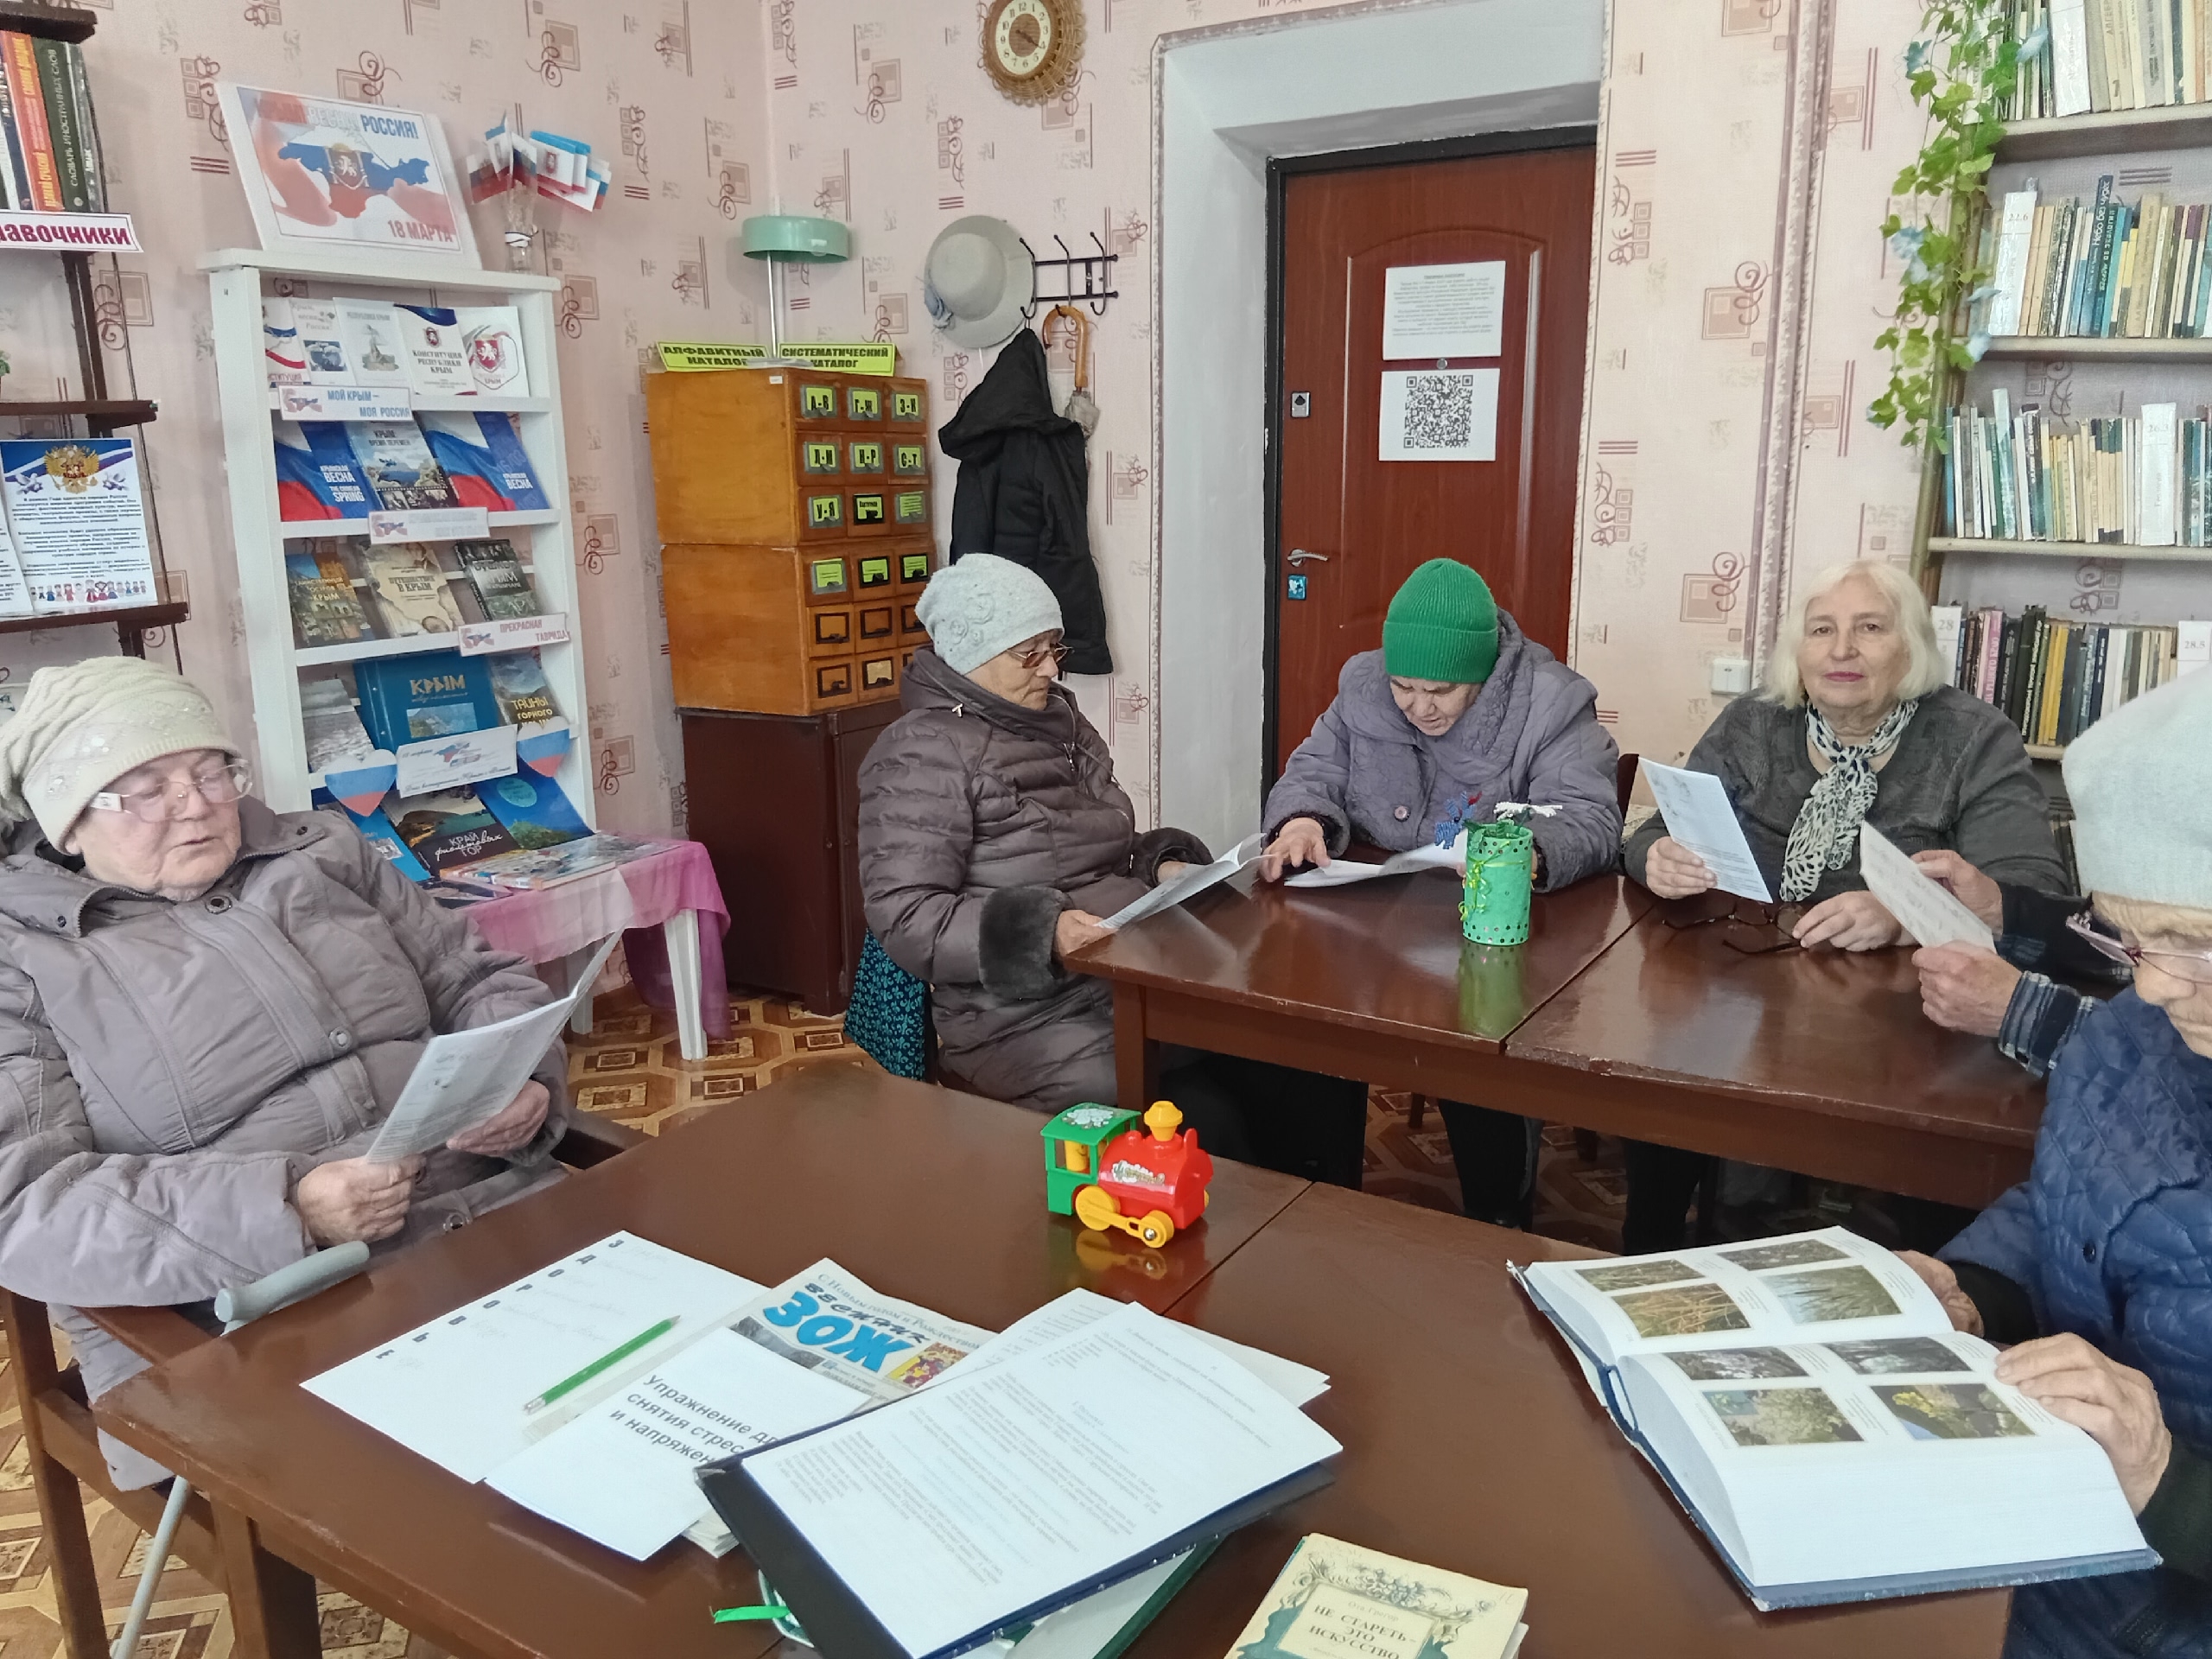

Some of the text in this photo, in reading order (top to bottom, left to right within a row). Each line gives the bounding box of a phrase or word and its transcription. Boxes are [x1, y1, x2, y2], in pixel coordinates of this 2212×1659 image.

[1019, 3, 1027, 11] 12
[1032, 3, 1035, 12] 1
[1009, 9, 1015, 18] 11
[1039, 12, 1045, 21] 2
[1002, 21, 1009, 30] 10
[1043, 26, 1048, 35] 3
[1001, 35, 1006, 44] 9
[1004, 49, 1009, 58] 8
[1033, 53, 1039, 62] 5
[1012, 58, 1017, 67] 7
[1022, 58, 1028, 67] 6
[48, 48, 79, 188] СЛОВАРЬ ИНОСТРАННЫХ СЛОВ
[360, 113, 420, 140] РОССИЯ!
[2096, 206, 2107, 221] без
[387, 219, 454, 243] 18 МАРТА
[2091, 222, 2104, 246] Небо
[412, 349, 462, 359] КОНСТИТУЦИЯ
[663, 346, 766, 358] АЛФАВИТНЫЙ
[781, 346, 889, 358] СИСТЕМАТИЧЕСКИЙ
[327, 389, 346, 401] МОЙ
[347, 391, 372, 402] КРЫМ
[359, 406, 410, 418] МОЯ РОССИЯ
[323, 471, 356, 483] ВЕСНА
[505, 478, 533, 490] ВЕСНА
[333, 491, 365, 502] SPRING
[406, 582, 433, 592] КРЫМ
[312, 593, 340, 601] КРЫМ
[499, 620, 543, 632] ПРЕКРАСНАЯ
[1938, 620, 1954, 631] 28
[2184, 640, 2206, 649] 28.5
[410, 674, 467, 696] КРЫМ
[511, 696, 549, 710] ТАЙНЫ
[517, 709, 553, 720] ГОРНОГО
[448, 831, 480, 847] КРАЙ
[461, 845, 482, 857] ГОР
[828, 1280, 868, 1310] Новым
[868, 1304, 903, 1320] годом
[763, 1291, 914, 1372] ЗОЖ
[644, 1374, 752, 1434] Упражнение
[608, 1409, 626, 1421] и
[627, 1393, 691, 1430] снятия
[1313, 1605, 1335, 1618] НЕ
[1340, 1614, 1408, 1642] СТАРЕТЬ
[1344, 1626, 1376, 1643] ЭТО
[1308, 1625, 1400, 1659] ИСКУССТВО
